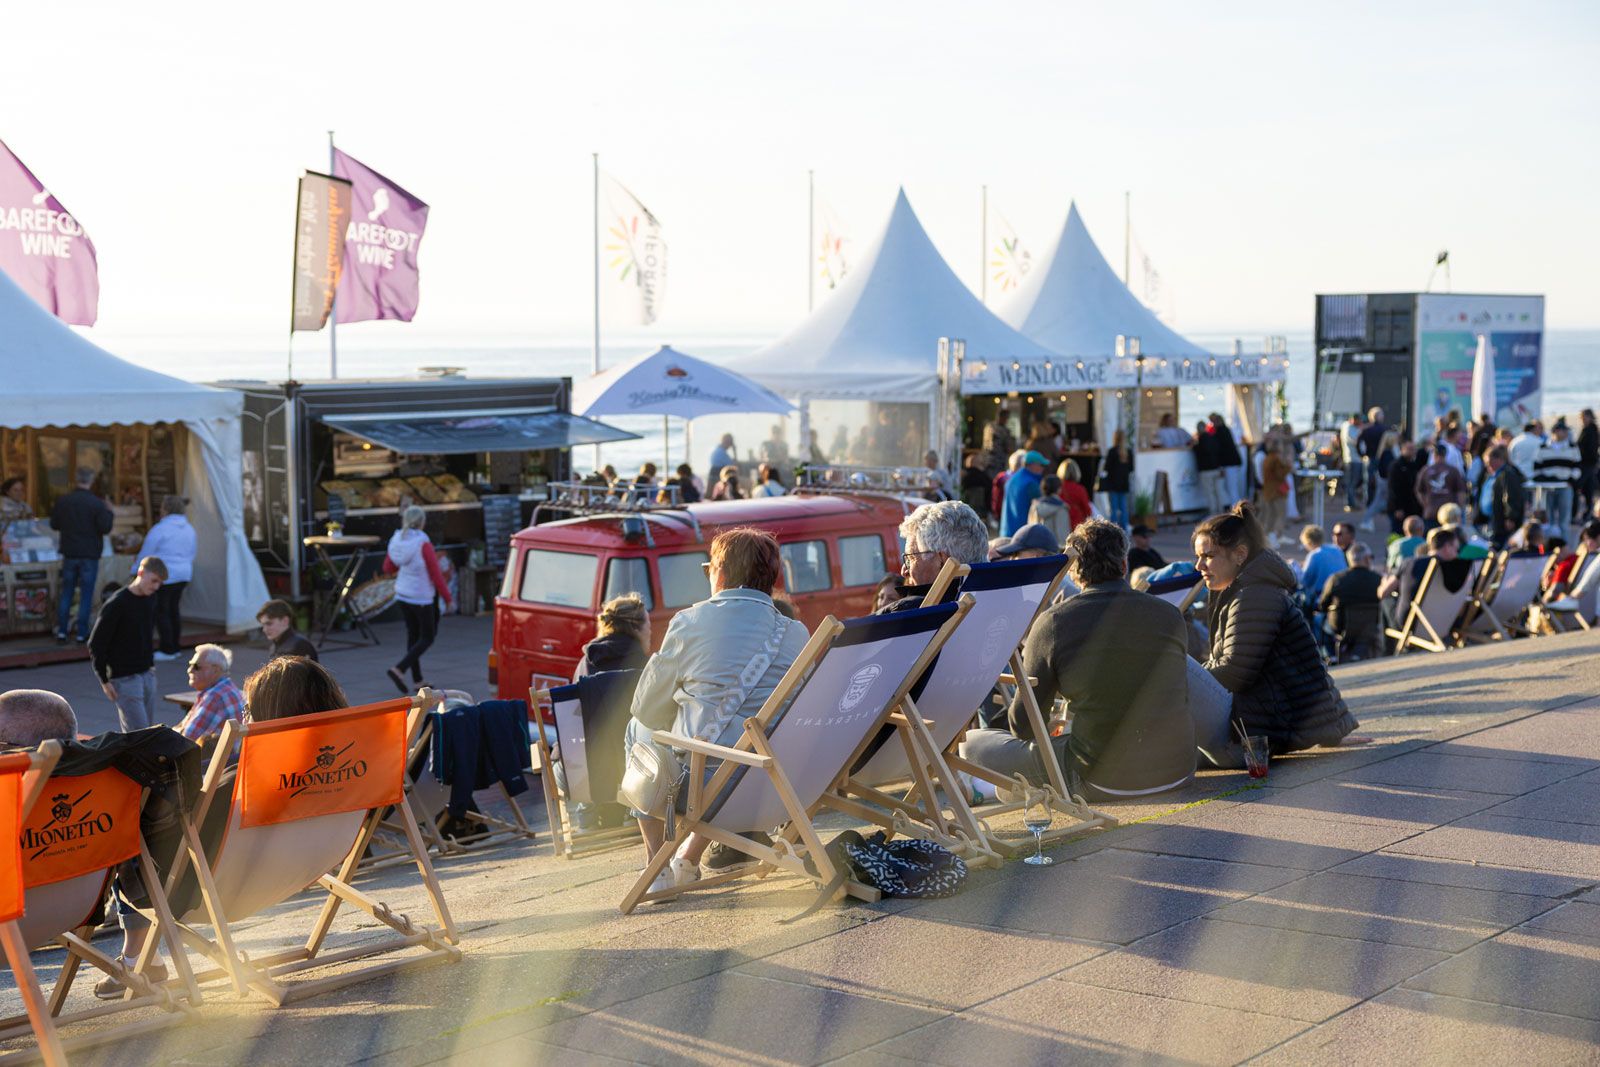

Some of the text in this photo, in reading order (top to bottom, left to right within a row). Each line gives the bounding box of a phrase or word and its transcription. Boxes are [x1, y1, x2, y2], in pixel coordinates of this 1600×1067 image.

[20, 232, 72, 259] WINE
[345, 221, 418, 252] AREFOOT
[1000, 361, 1107, 386] WEINLOUNGE
